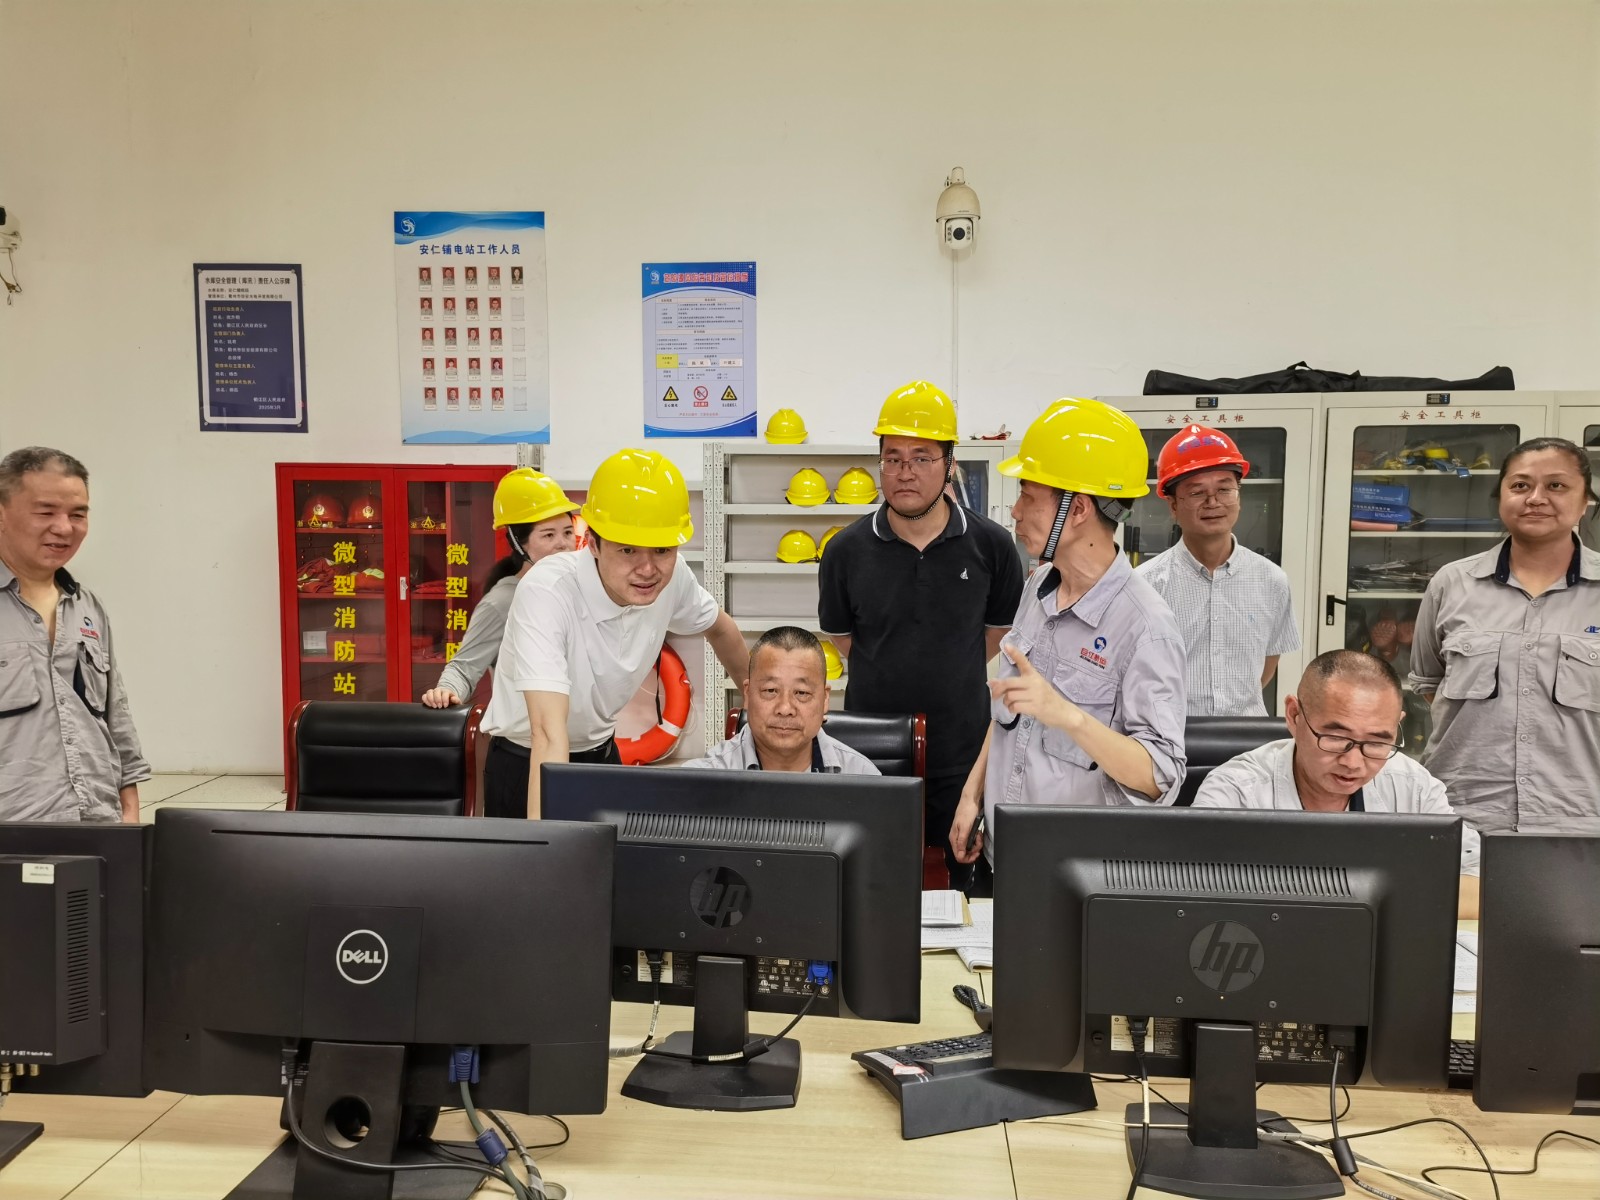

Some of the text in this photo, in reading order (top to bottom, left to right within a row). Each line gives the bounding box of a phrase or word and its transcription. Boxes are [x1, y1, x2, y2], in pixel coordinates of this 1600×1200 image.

[419, 244, 521, 255] 安仁铺电站工作人员
[1165, 414, 1245, 424] 安全工具柜
[1399, 409, 1482, 420] 安全工具柜
[333, 541, 357, 694] 微型消防站
[342, 948, 382, 965] DELL
[1198, 922, 1260, 992] hp
